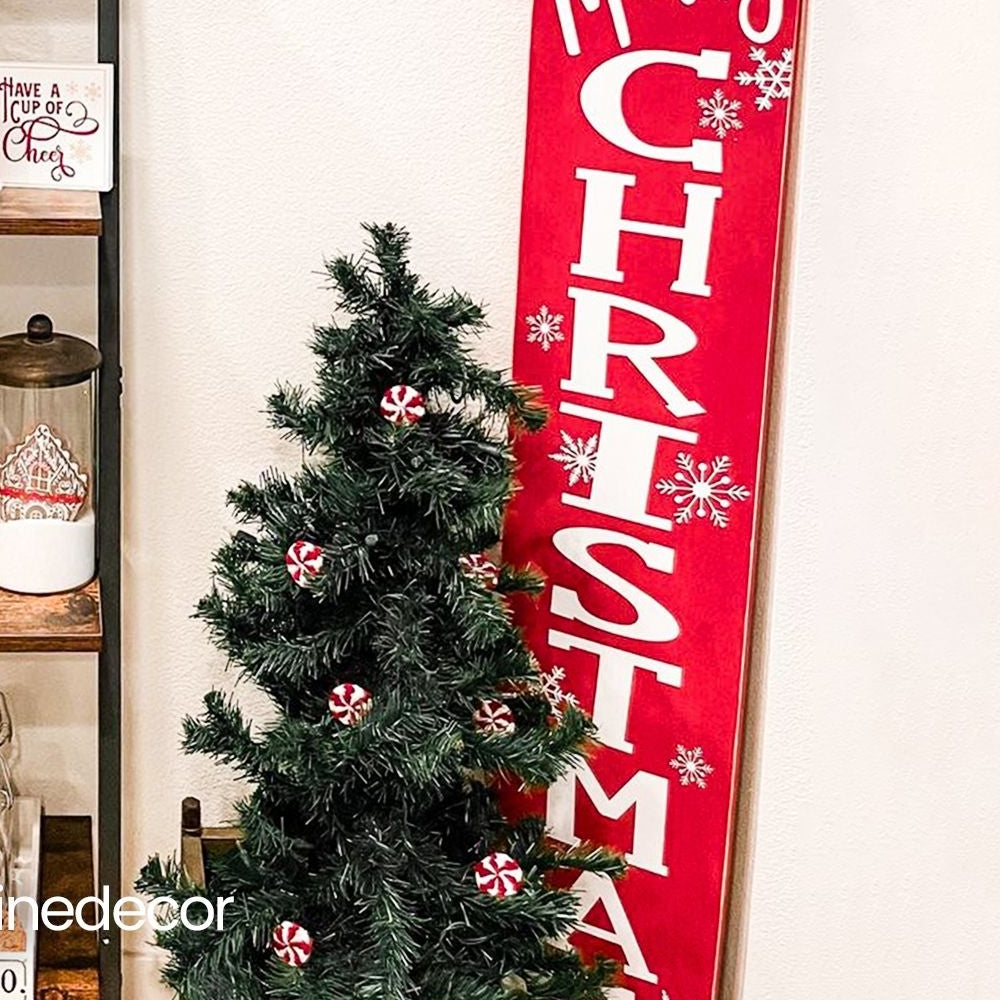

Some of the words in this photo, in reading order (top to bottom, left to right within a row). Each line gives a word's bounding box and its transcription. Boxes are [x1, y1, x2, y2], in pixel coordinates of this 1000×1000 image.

[10, 100, 41, 124] CUP
[45, 100, 64, 115] OF
[50, 83, 61, 98] A
[3, 112, 99, 182] Cheer
[544, 48, 732, 1000] CHRISTMA
